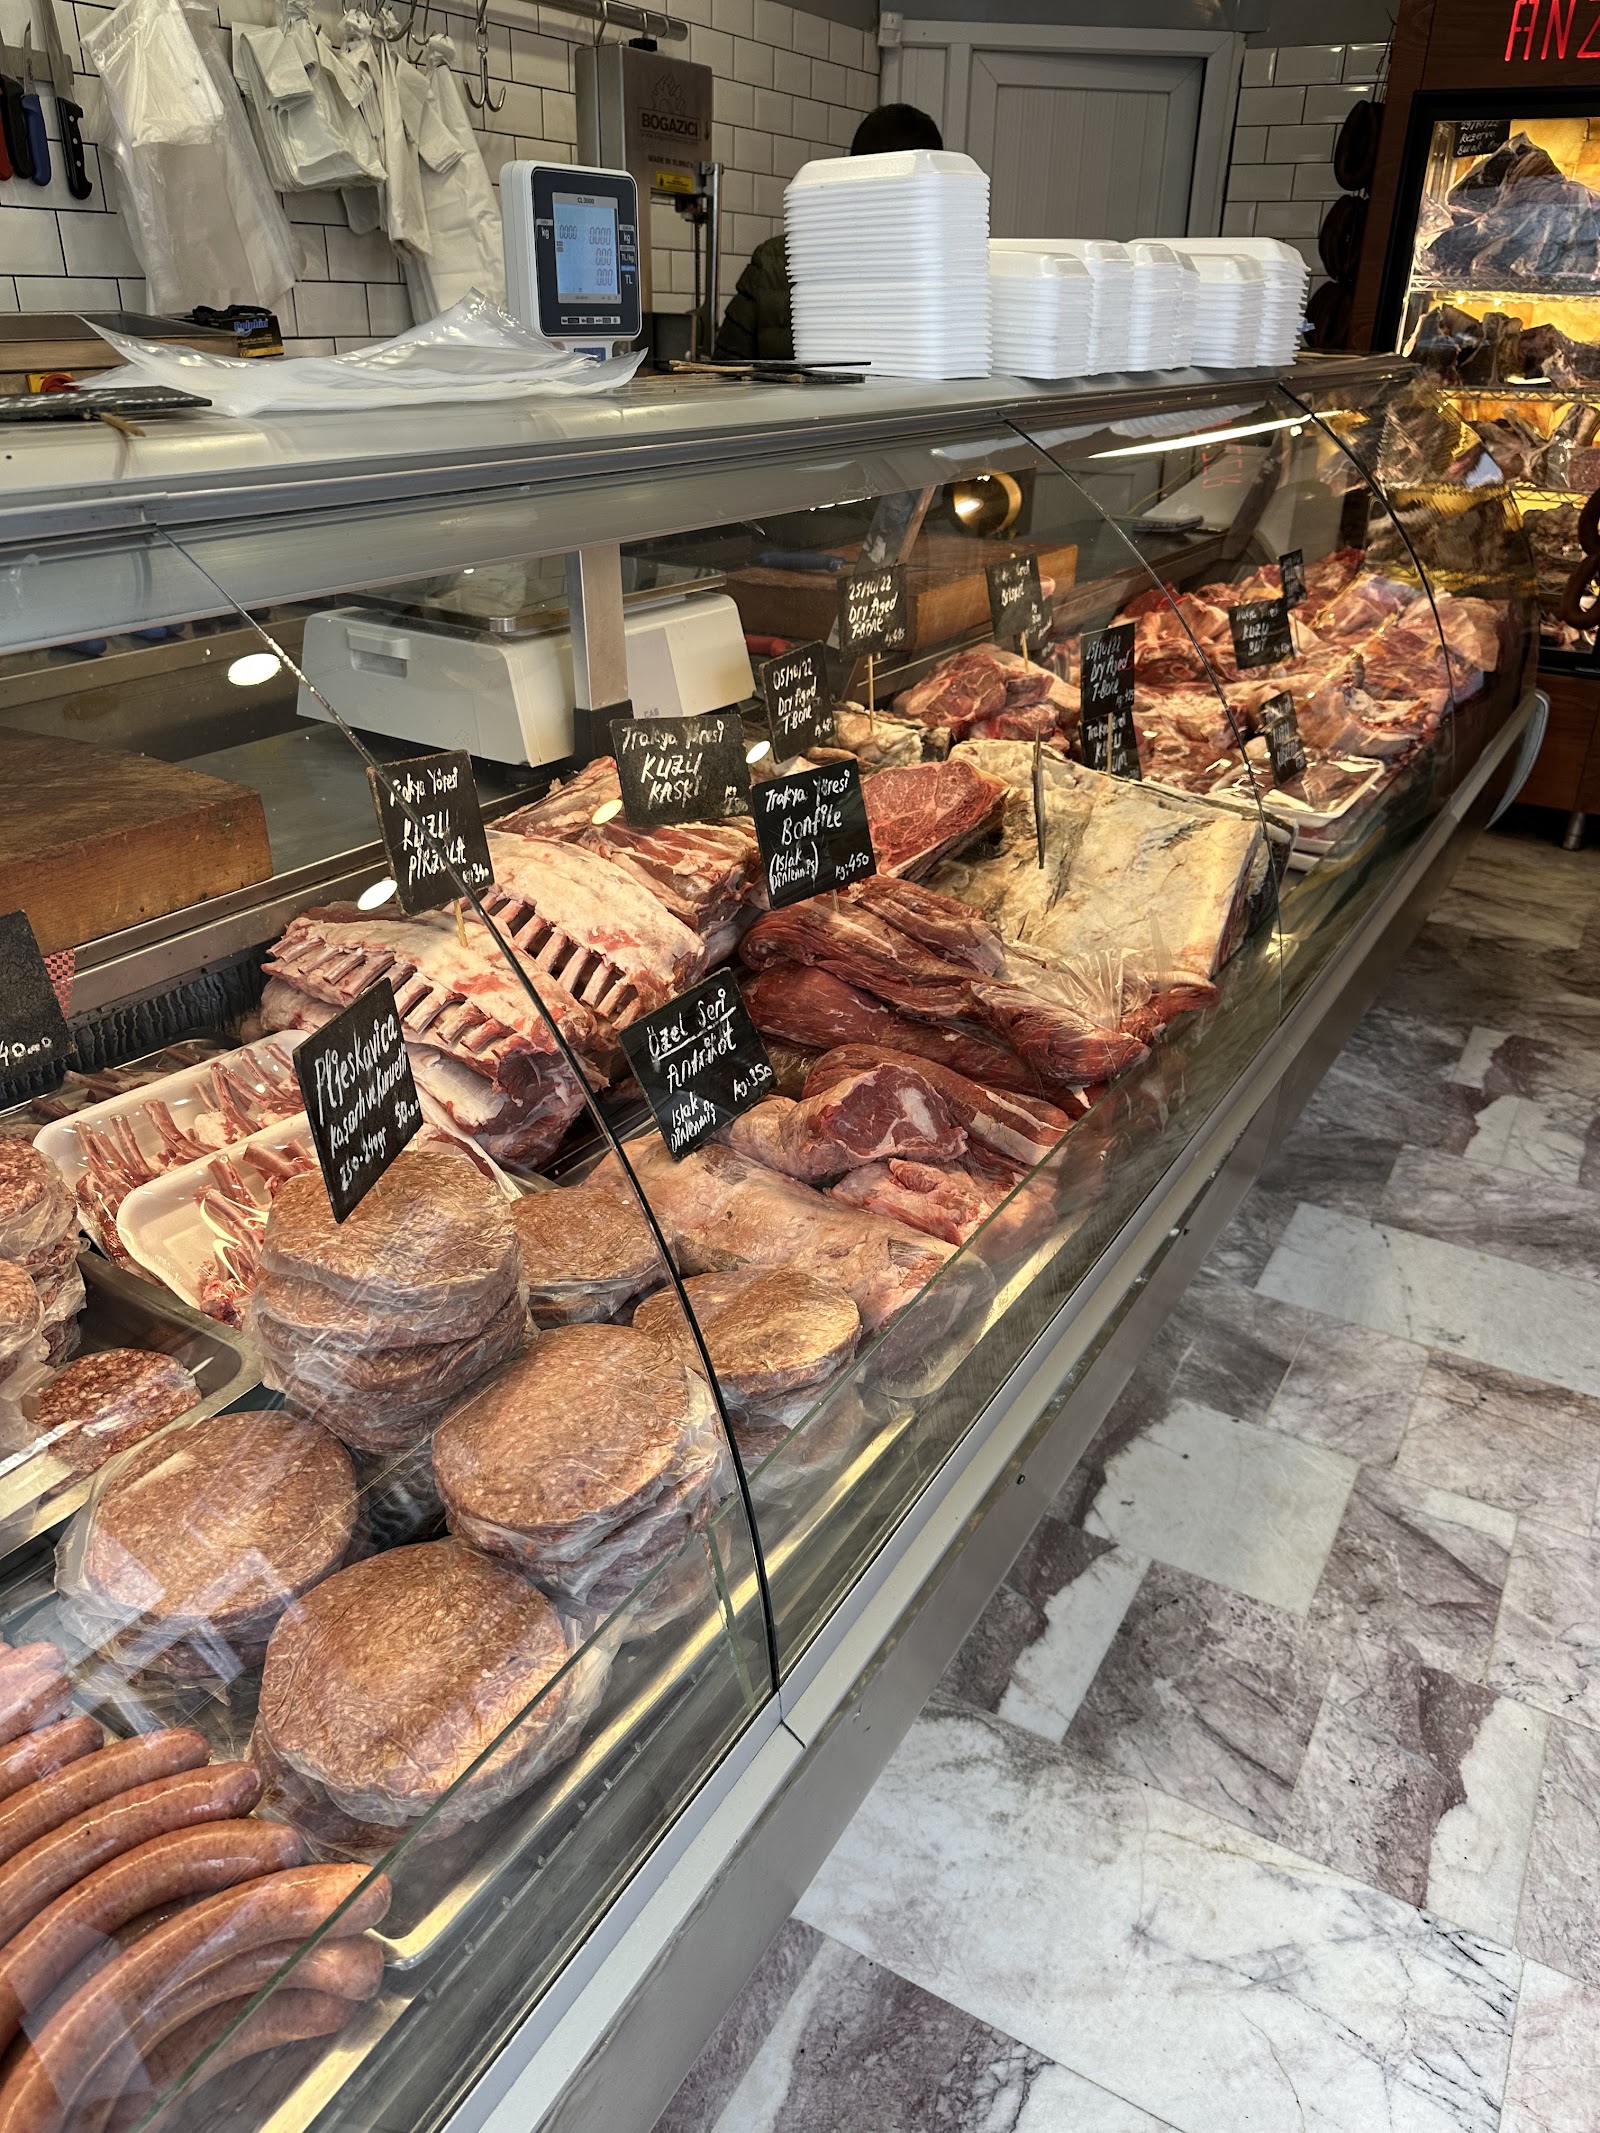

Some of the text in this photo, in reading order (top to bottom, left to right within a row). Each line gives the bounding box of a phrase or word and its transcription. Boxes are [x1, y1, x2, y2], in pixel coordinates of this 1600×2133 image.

[541, 227, 550, 240] kg
[623, 232, 631, 244] kg
[625, 274, 633, 285] TL
[849, 575, 892, 600] 25/10/22
[848, 605, 868, 624] Dry
[773, 657, 813, 690] 05/10/22
[778, 696, 793, 716] Dry
[1094, 732, 1122, 763] KUU
[765, 785, 808, 812] Trakya
[646, 988, 726, 1062] Özel Seri
